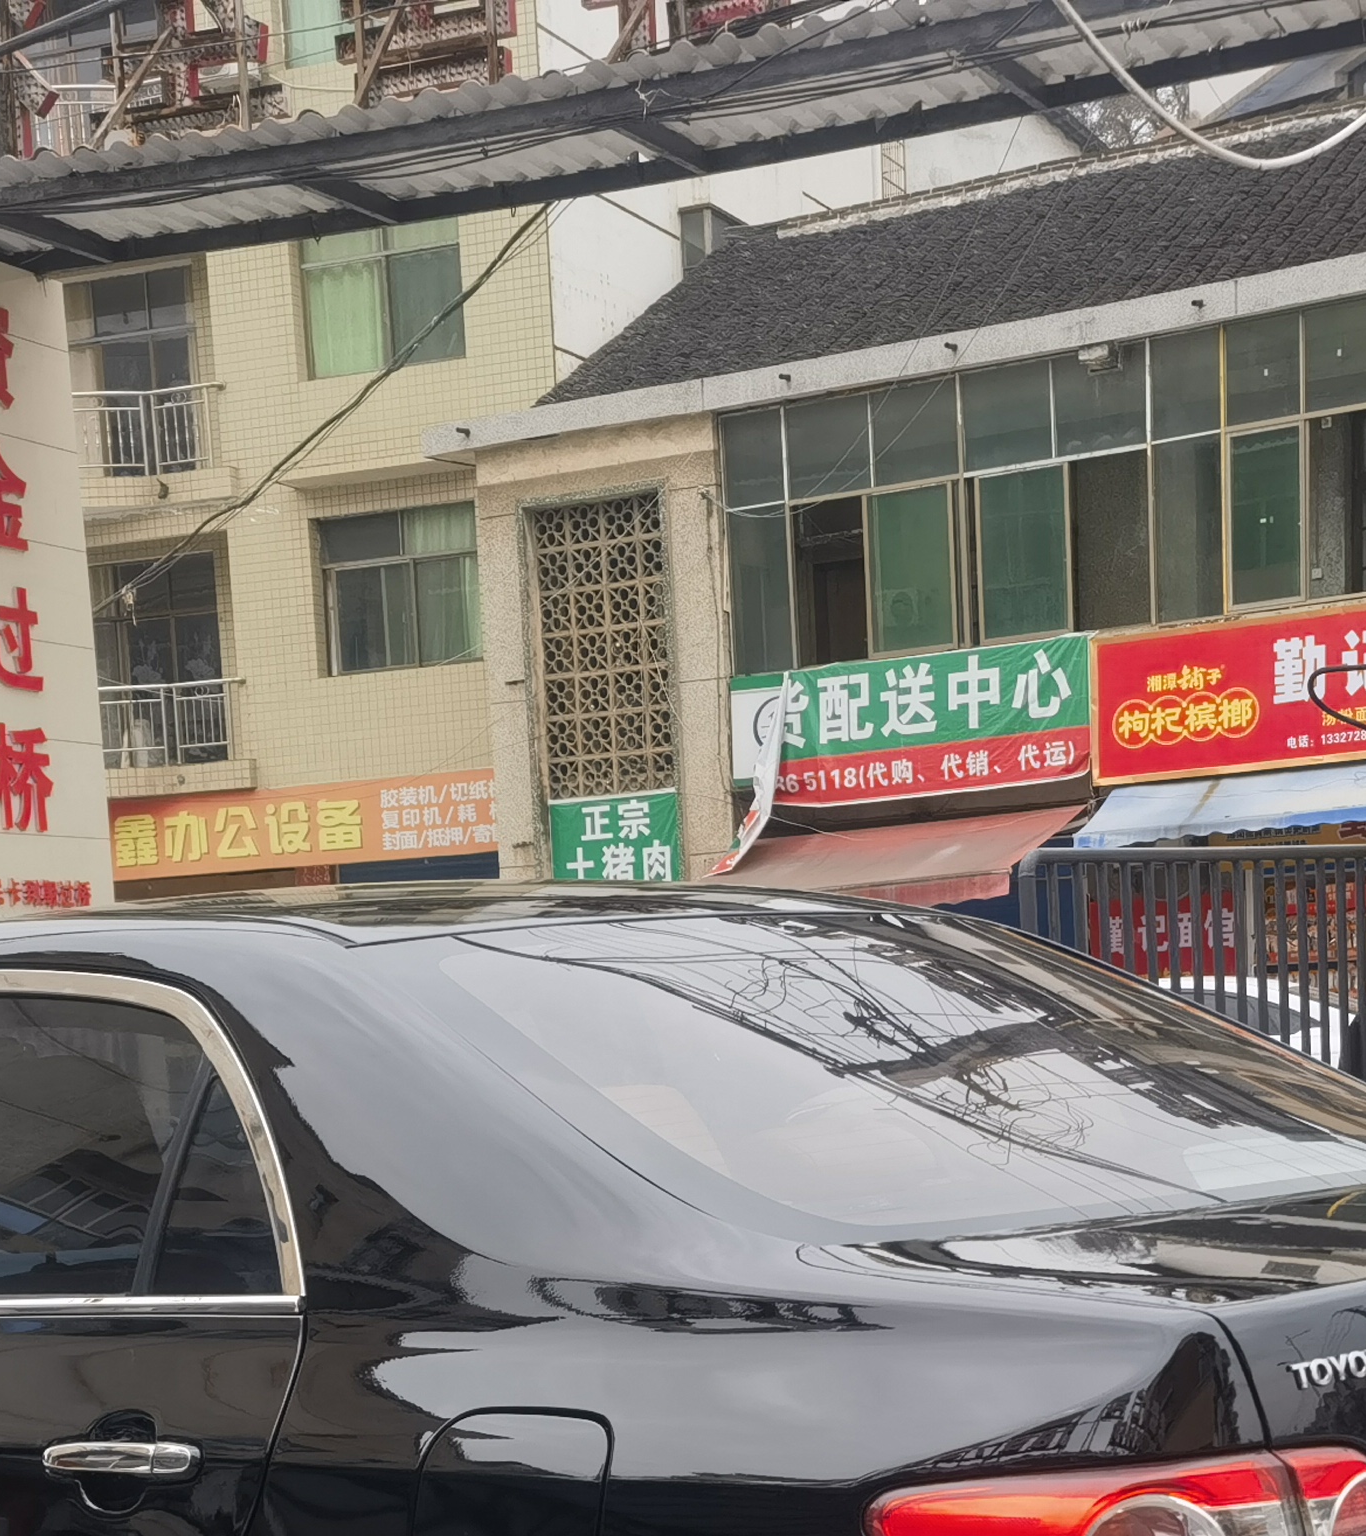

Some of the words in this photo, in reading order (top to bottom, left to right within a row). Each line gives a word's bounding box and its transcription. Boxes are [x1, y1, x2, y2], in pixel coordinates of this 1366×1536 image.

[1119, 698, 1253, 740] 枸杞槟榔
[114, 799, 363, 868] 鑫办公设备
[581, 799, 651, 842] 正宗
